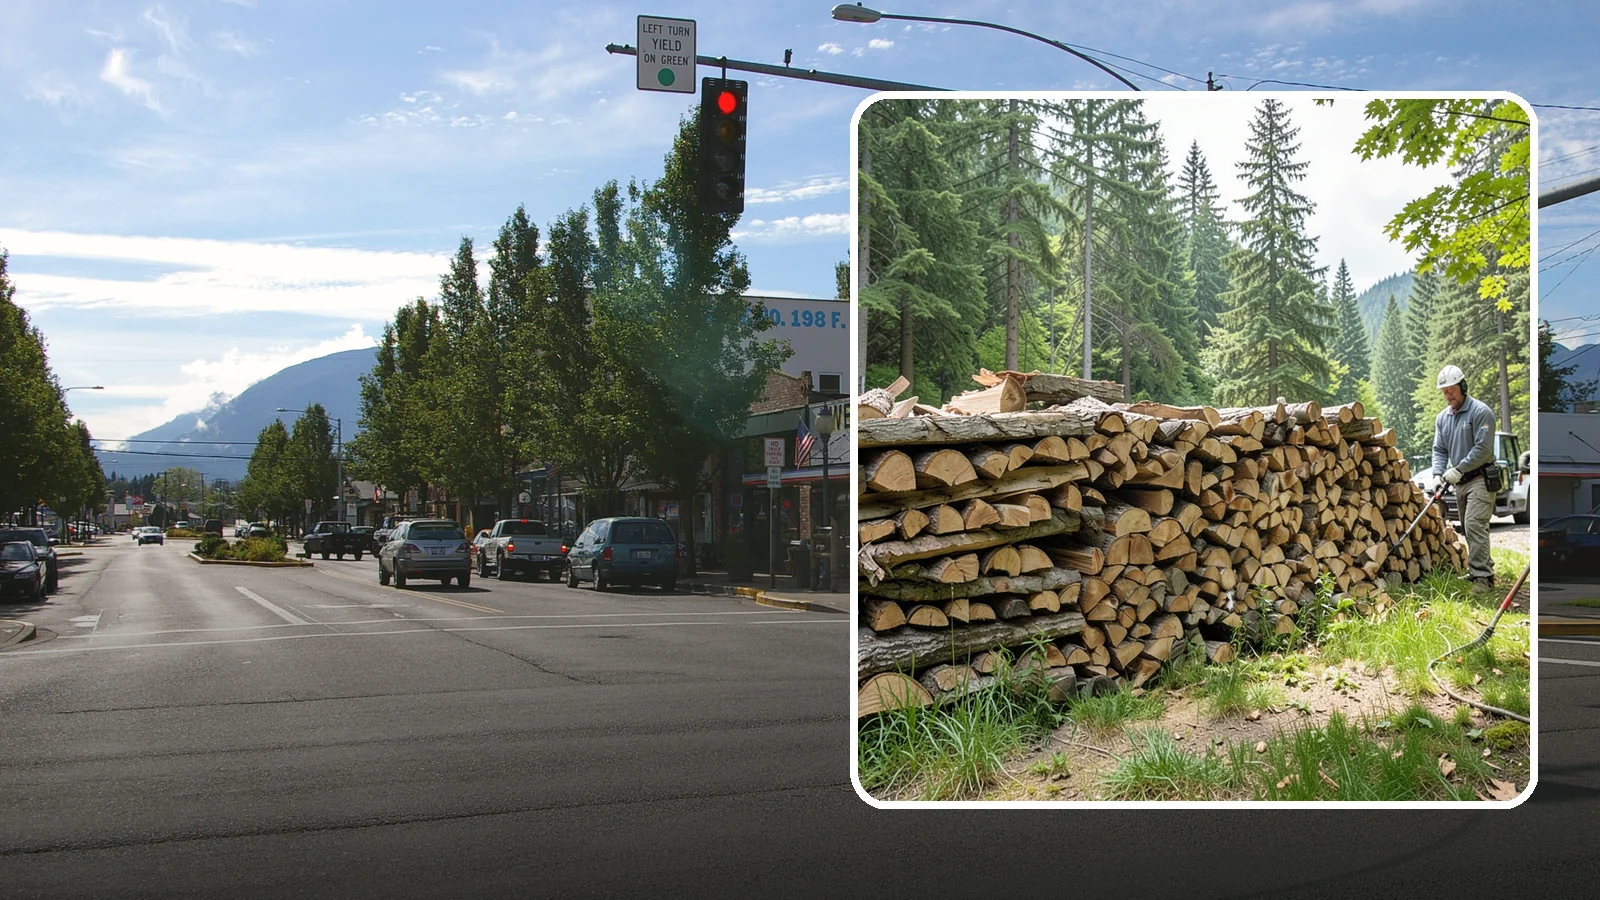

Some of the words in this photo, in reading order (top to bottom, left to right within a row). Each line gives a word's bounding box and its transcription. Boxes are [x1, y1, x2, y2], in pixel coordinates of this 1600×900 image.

[643, 24, 663, 34] LEFT
[668, 25, 690, 37] TURN
[652, 38, 682, 52] YIELD
[644, 53, 656, 64] ON
[661, 54, 689, 66] GREEN
[791, 309, 826, 328] 198
[831, 311, 846, 329] F.
